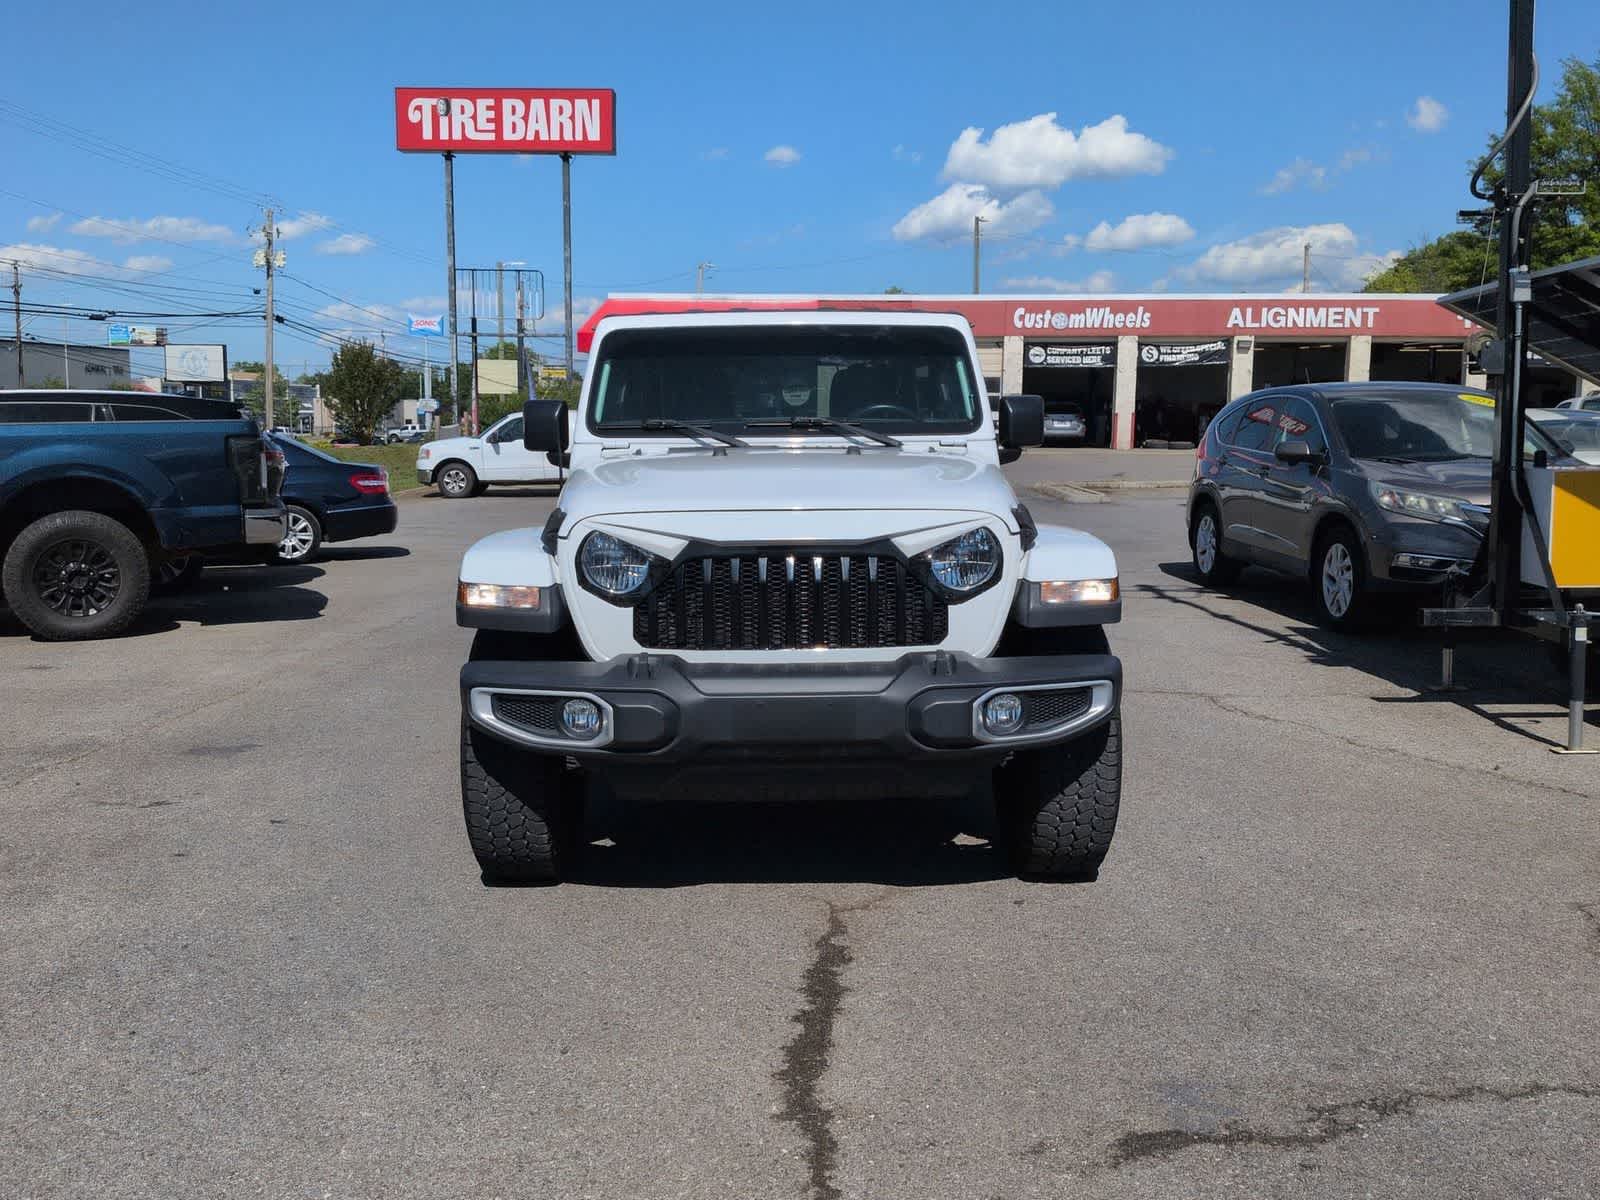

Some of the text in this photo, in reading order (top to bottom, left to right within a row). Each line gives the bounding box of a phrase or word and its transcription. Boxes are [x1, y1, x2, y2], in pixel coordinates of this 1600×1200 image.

[408, 97, 600, 141] TIRE BARN
[414, 319, 437, 327] SONIC
[1227, 307, 1380, 328] ALIGNMENT
